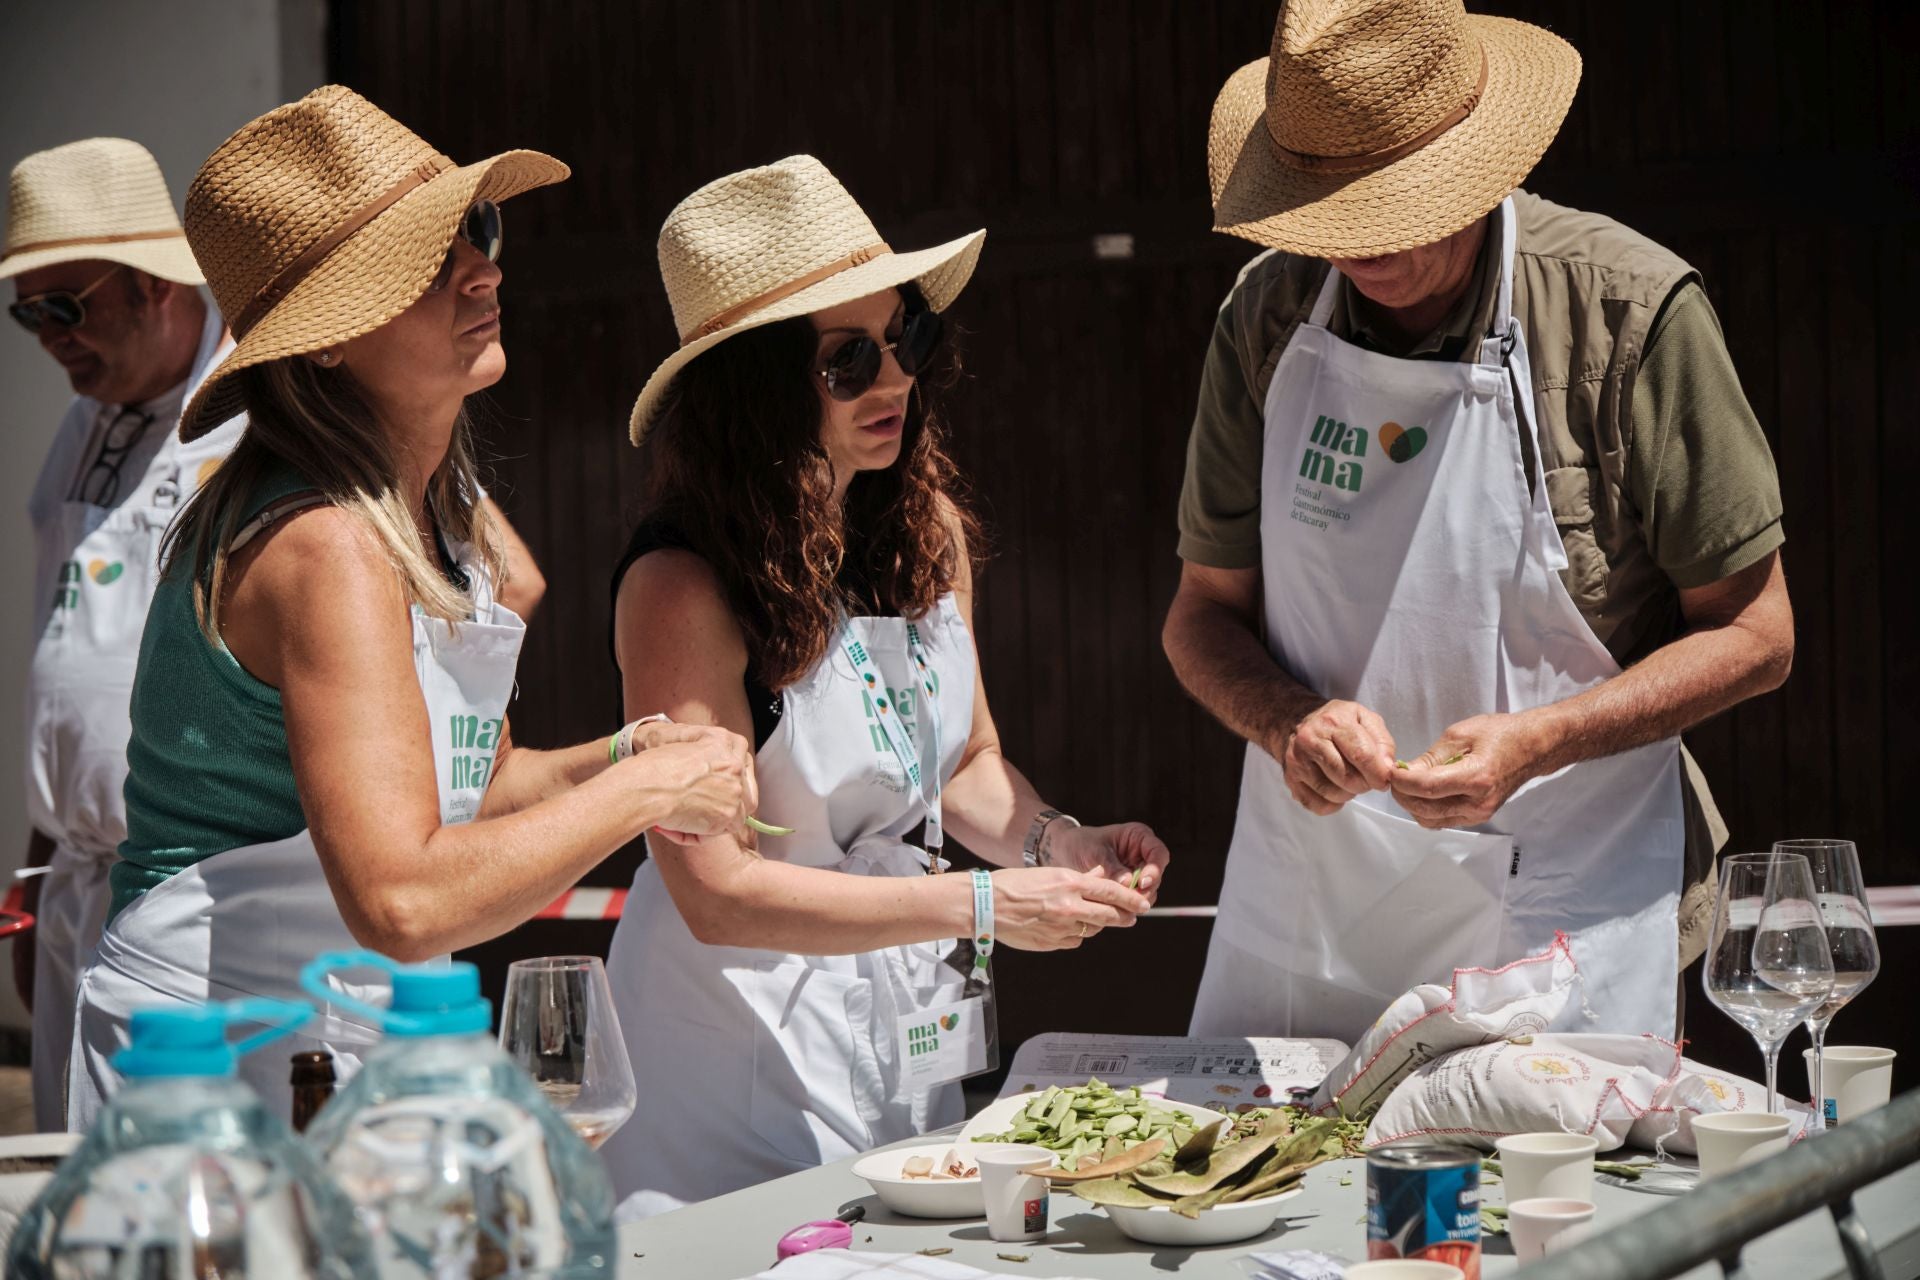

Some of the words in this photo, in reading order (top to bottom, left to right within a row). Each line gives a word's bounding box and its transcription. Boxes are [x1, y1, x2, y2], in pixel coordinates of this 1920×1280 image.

[1309, 415, 1368, 457] ma
[1298, 448, 1363, 492] ma
[1295, 484, 1322, 501] Festival
[1290, 509, 1299, 520] de
[1298, 512, 1329, 532] Ezcaray
[1293, 497, 1350, 521] Gastronómico
[450, 715, 504, 750] ma
[451, 755, 492, 790] ma
[908, 1022, 937, 1041] ma
[909, 1038, 940, 1056] ma
